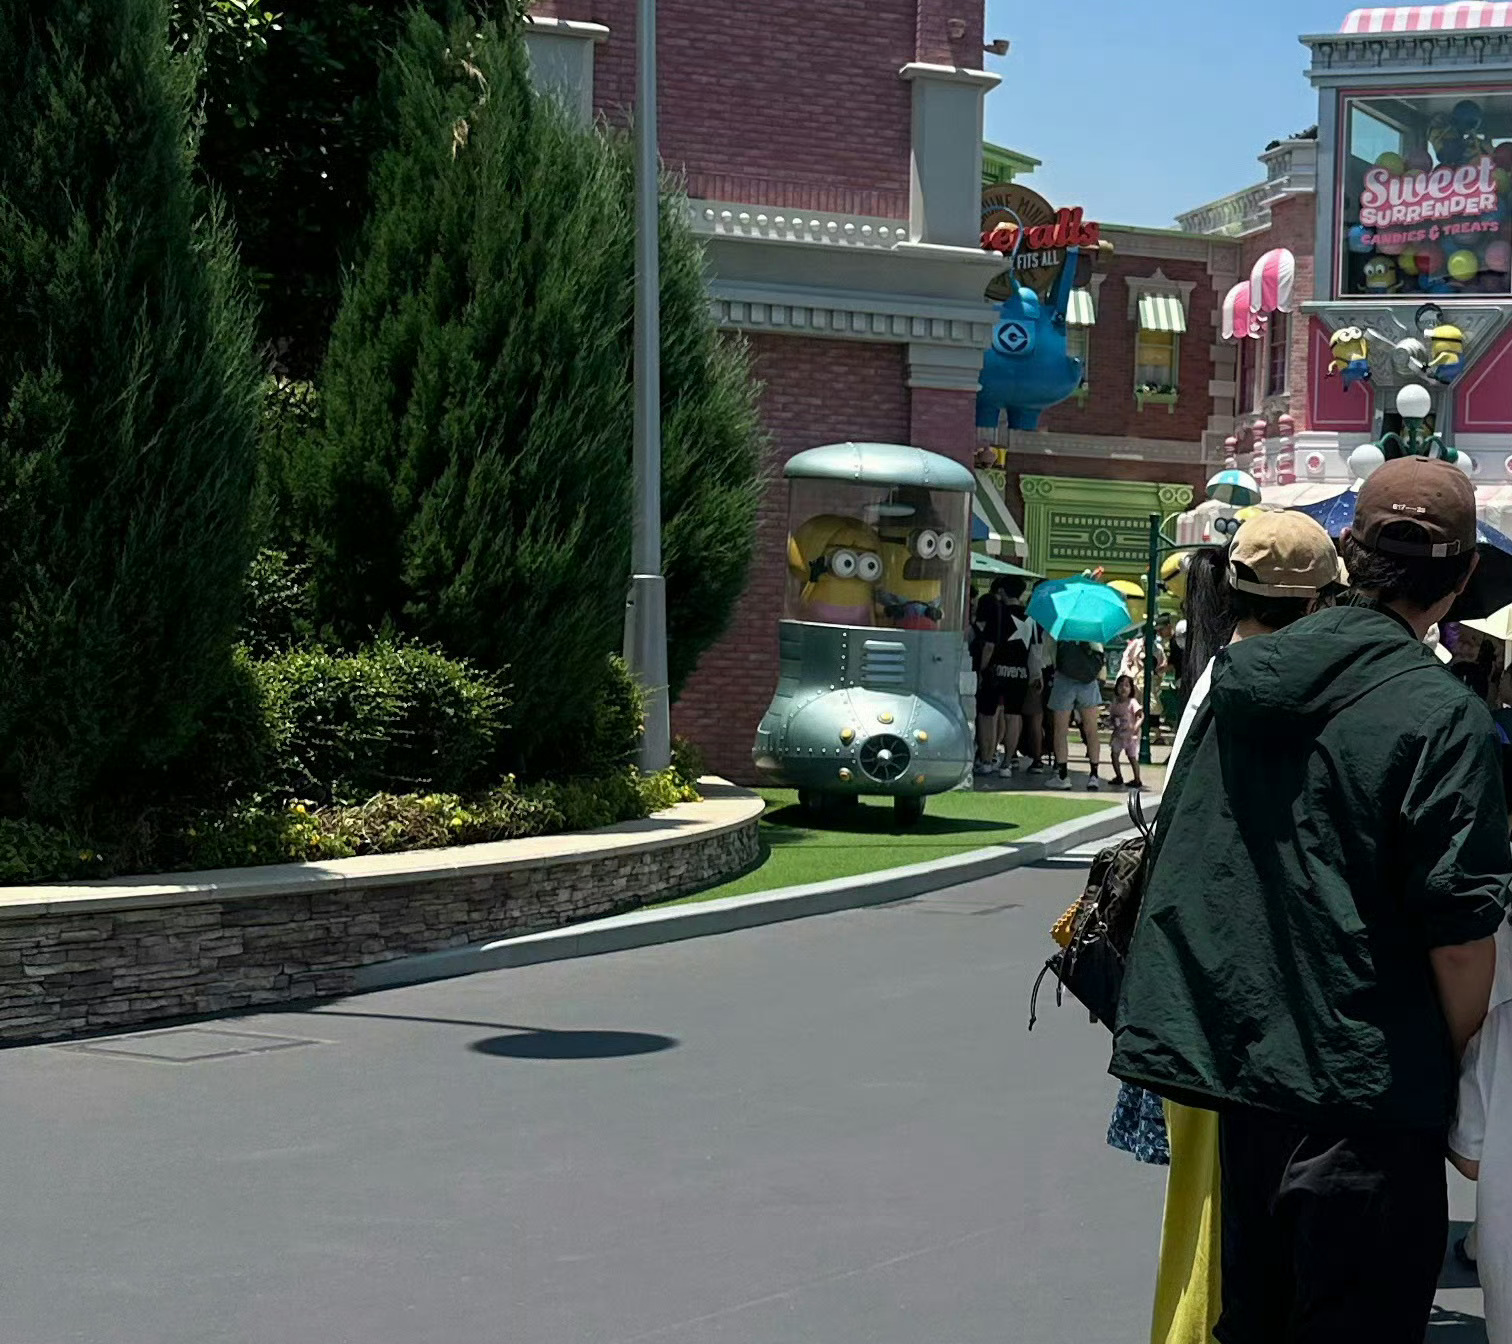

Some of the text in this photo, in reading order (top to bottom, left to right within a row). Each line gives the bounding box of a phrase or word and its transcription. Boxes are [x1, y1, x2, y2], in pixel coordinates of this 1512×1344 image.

[1361, 156, 1497, 207] Sweet
[1360, 193, 1497, 228] SURRENDER
[1361, 222, 1499, 245] CANDIES & TREATS
[1017, 249, 1061, 270] FITS ALL
